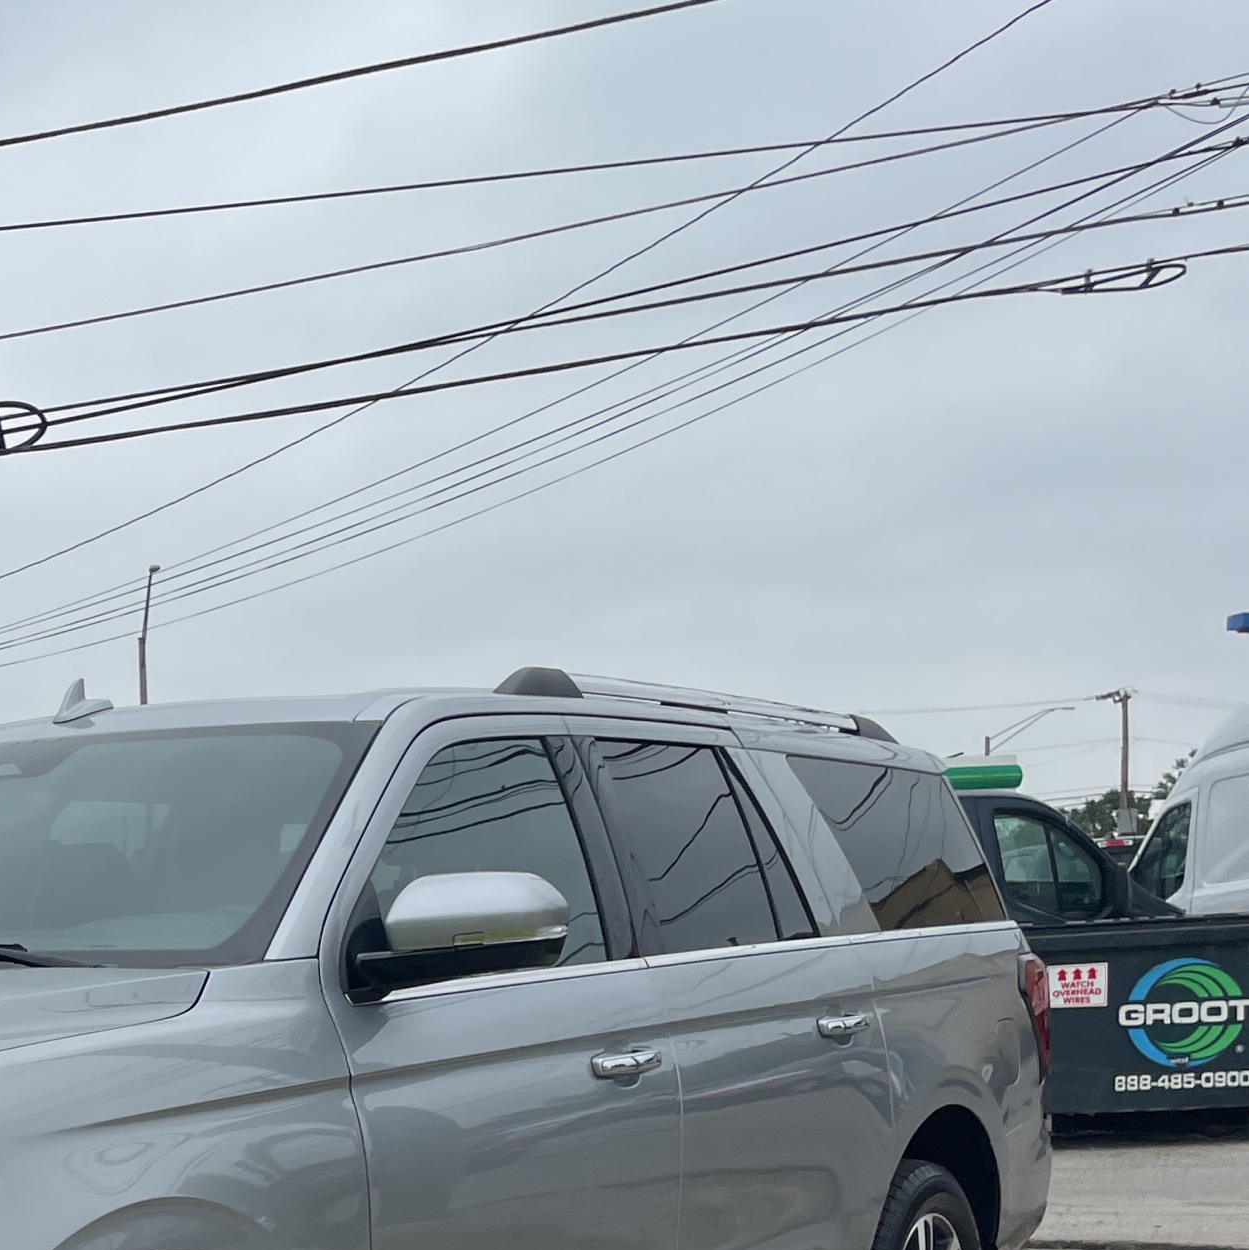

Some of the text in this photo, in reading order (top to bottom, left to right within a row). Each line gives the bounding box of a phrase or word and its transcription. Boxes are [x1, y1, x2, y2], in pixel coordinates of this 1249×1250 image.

[1061, 981, 1094, 989] WATCH
[1052, 988, 1102, 998] OVERHEAD
[1063, 996, 1090, 1004] WIRES
[1118, 999, 1249, 1027] GROOT
[1114, 1070, 1249, 1092] 888-485-0900
